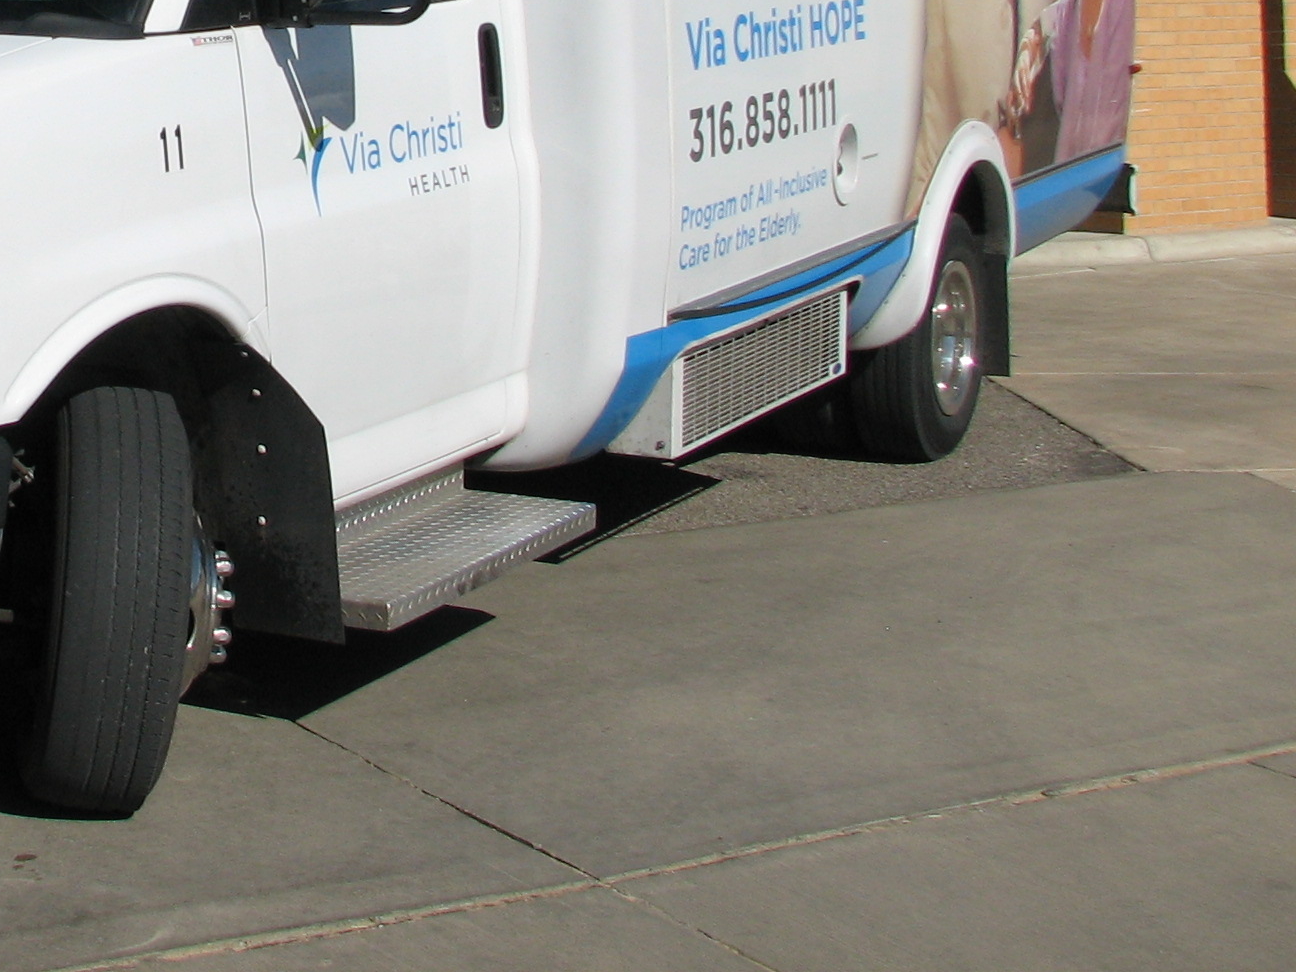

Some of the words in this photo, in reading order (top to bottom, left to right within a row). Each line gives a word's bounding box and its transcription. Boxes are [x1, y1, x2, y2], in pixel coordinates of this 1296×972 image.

[685, 17, 726, 70] Via
[733, 5, 803, 62] Christi
[340, 130, 381, 174] Via
[389, 112, 464, 163] Christi
[689, 79, 836, 162] 316.858.1111
[160, 124, 184, 172] 11
[409, 165, 470, 196] HEALTH
[681, 196, 736, 232] Program
[740, 184, 754, 212] of
[679, 243, 710, 270] Care
[713, 232, 733, 259] for
[736, 224, 755, 251] the
